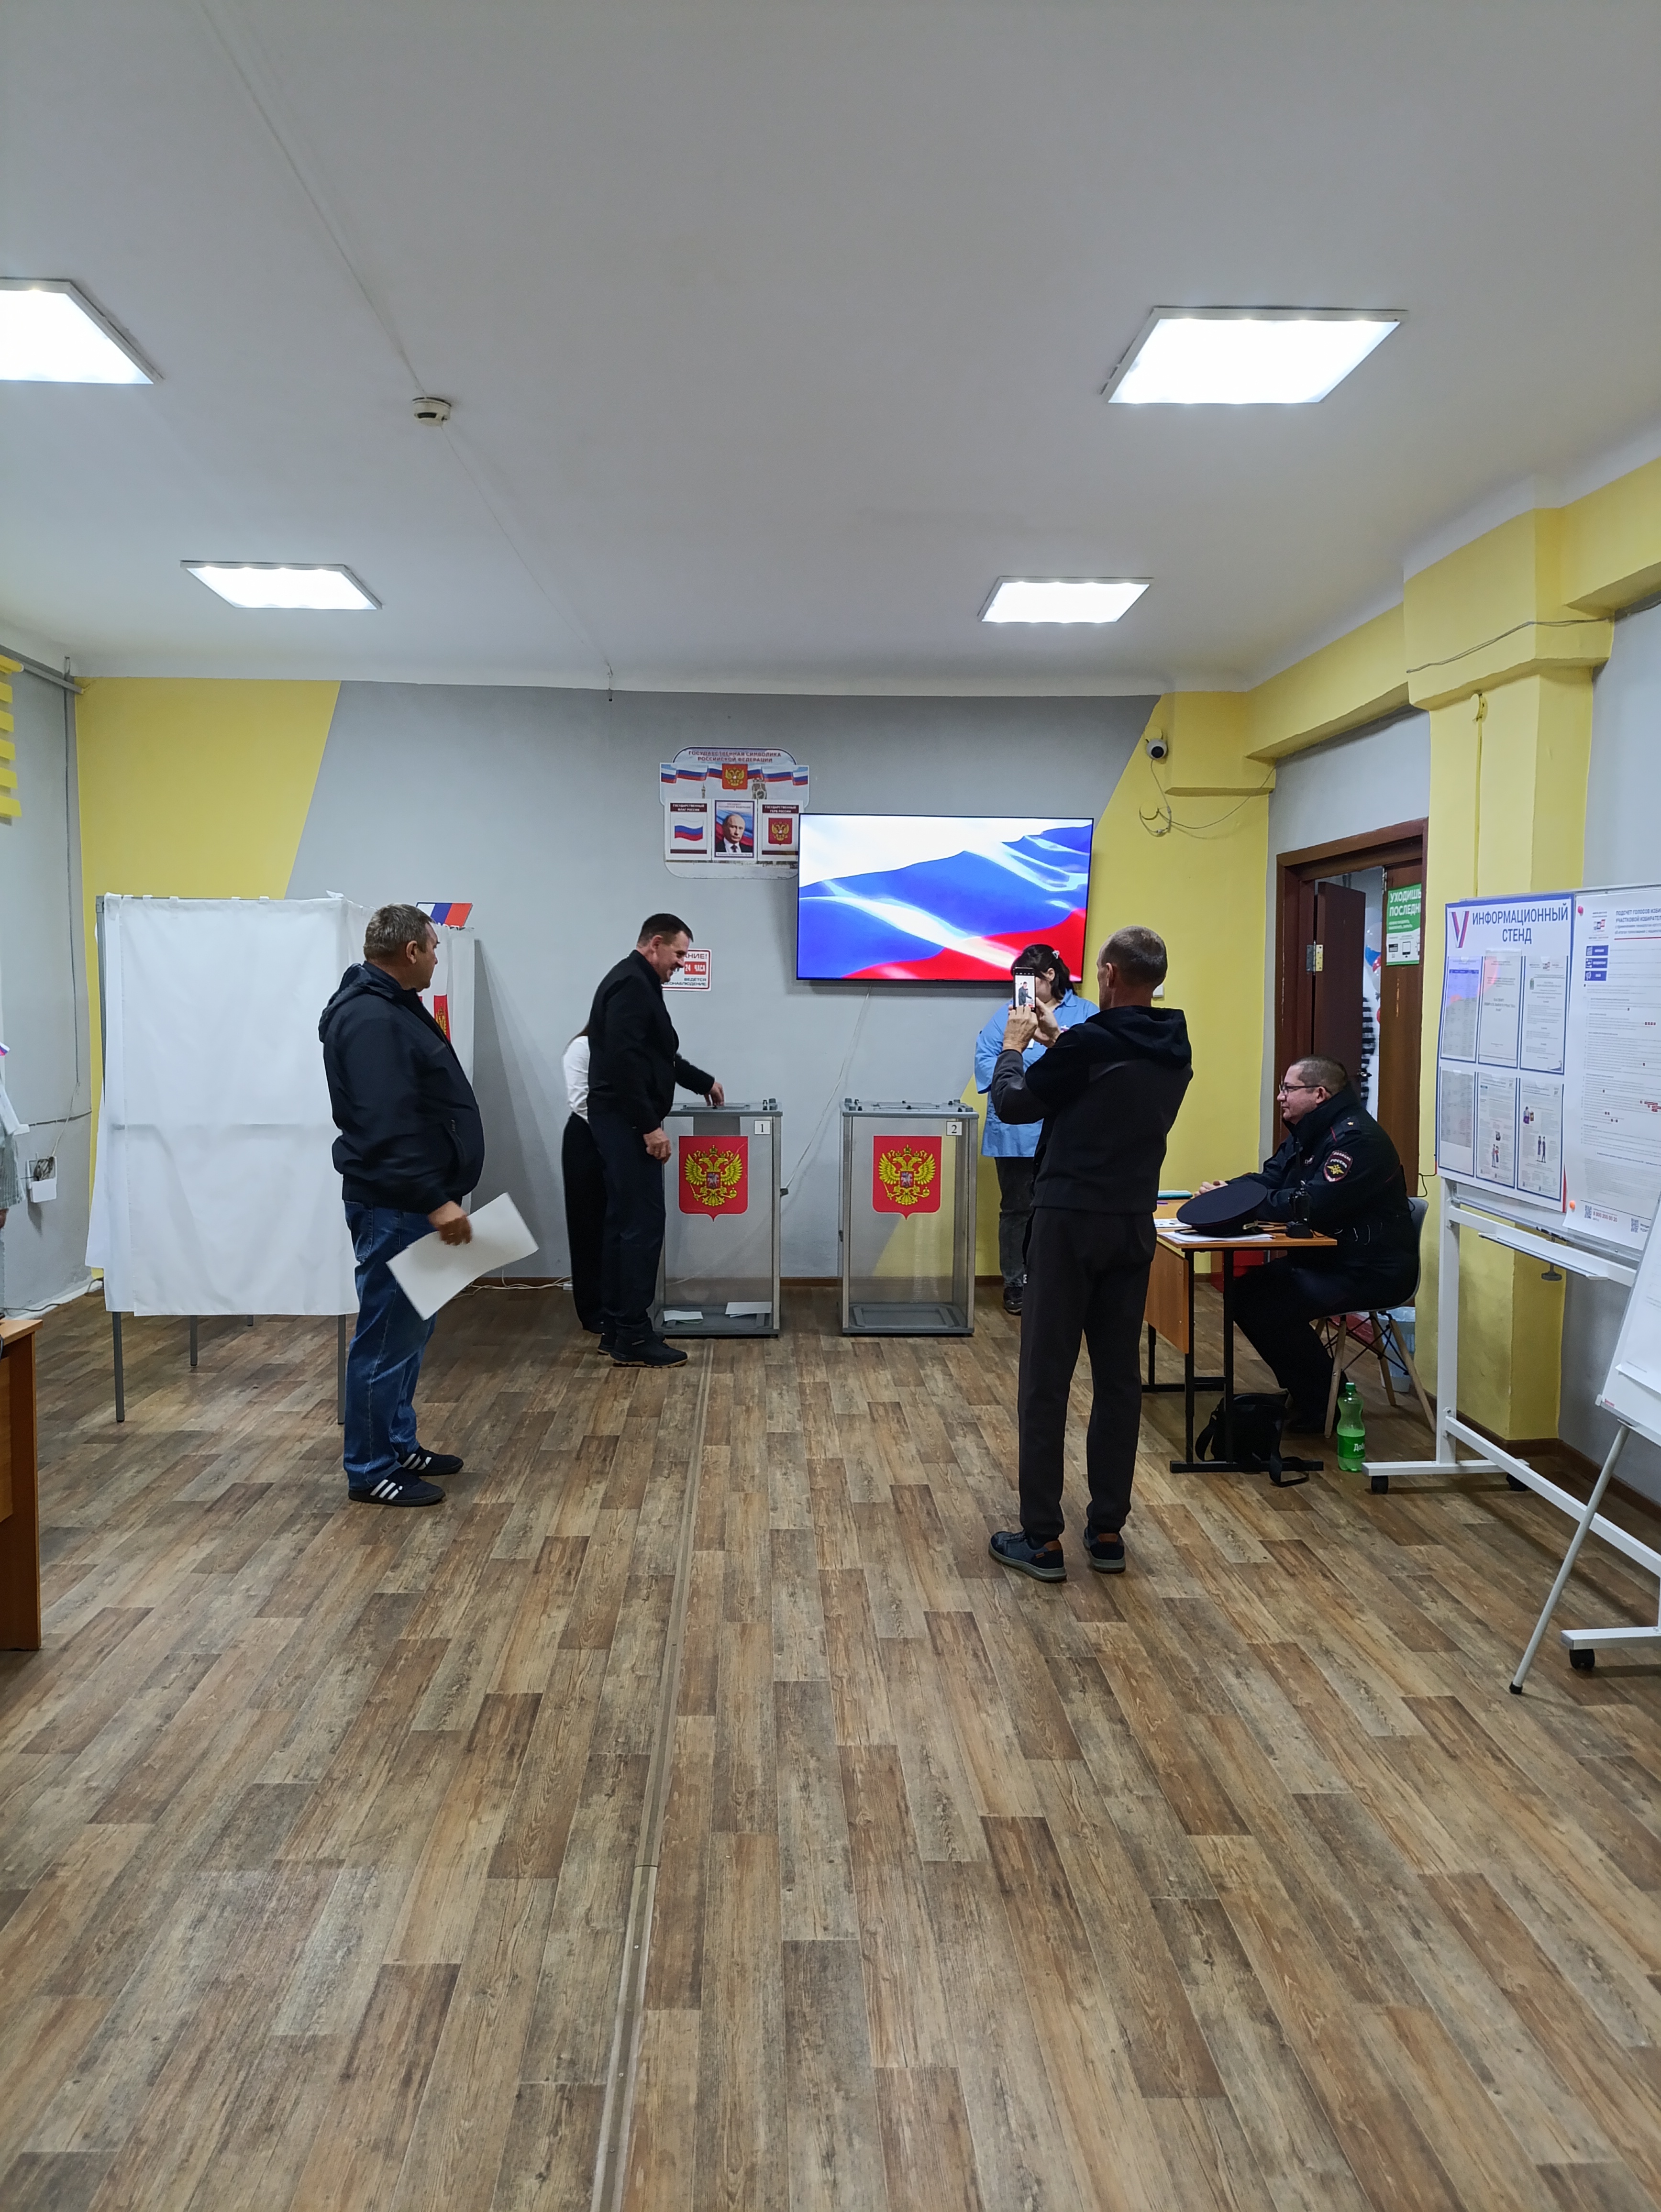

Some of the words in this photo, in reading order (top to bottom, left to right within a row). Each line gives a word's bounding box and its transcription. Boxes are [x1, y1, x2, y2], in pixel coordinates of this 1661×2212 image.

[1390, 889, 1421, 903] УХОДИШЬ
[1473, 903, 1568, 926] ИНФОРМАЦИОННЫЙ
[1502, 928, 1532, 944] СТЕНД
[761, 1124, 764, 1132] 1
[952, 1125, 957, 1133] 2
[1330, 1159, 1347, 1168] РОССИЯ
